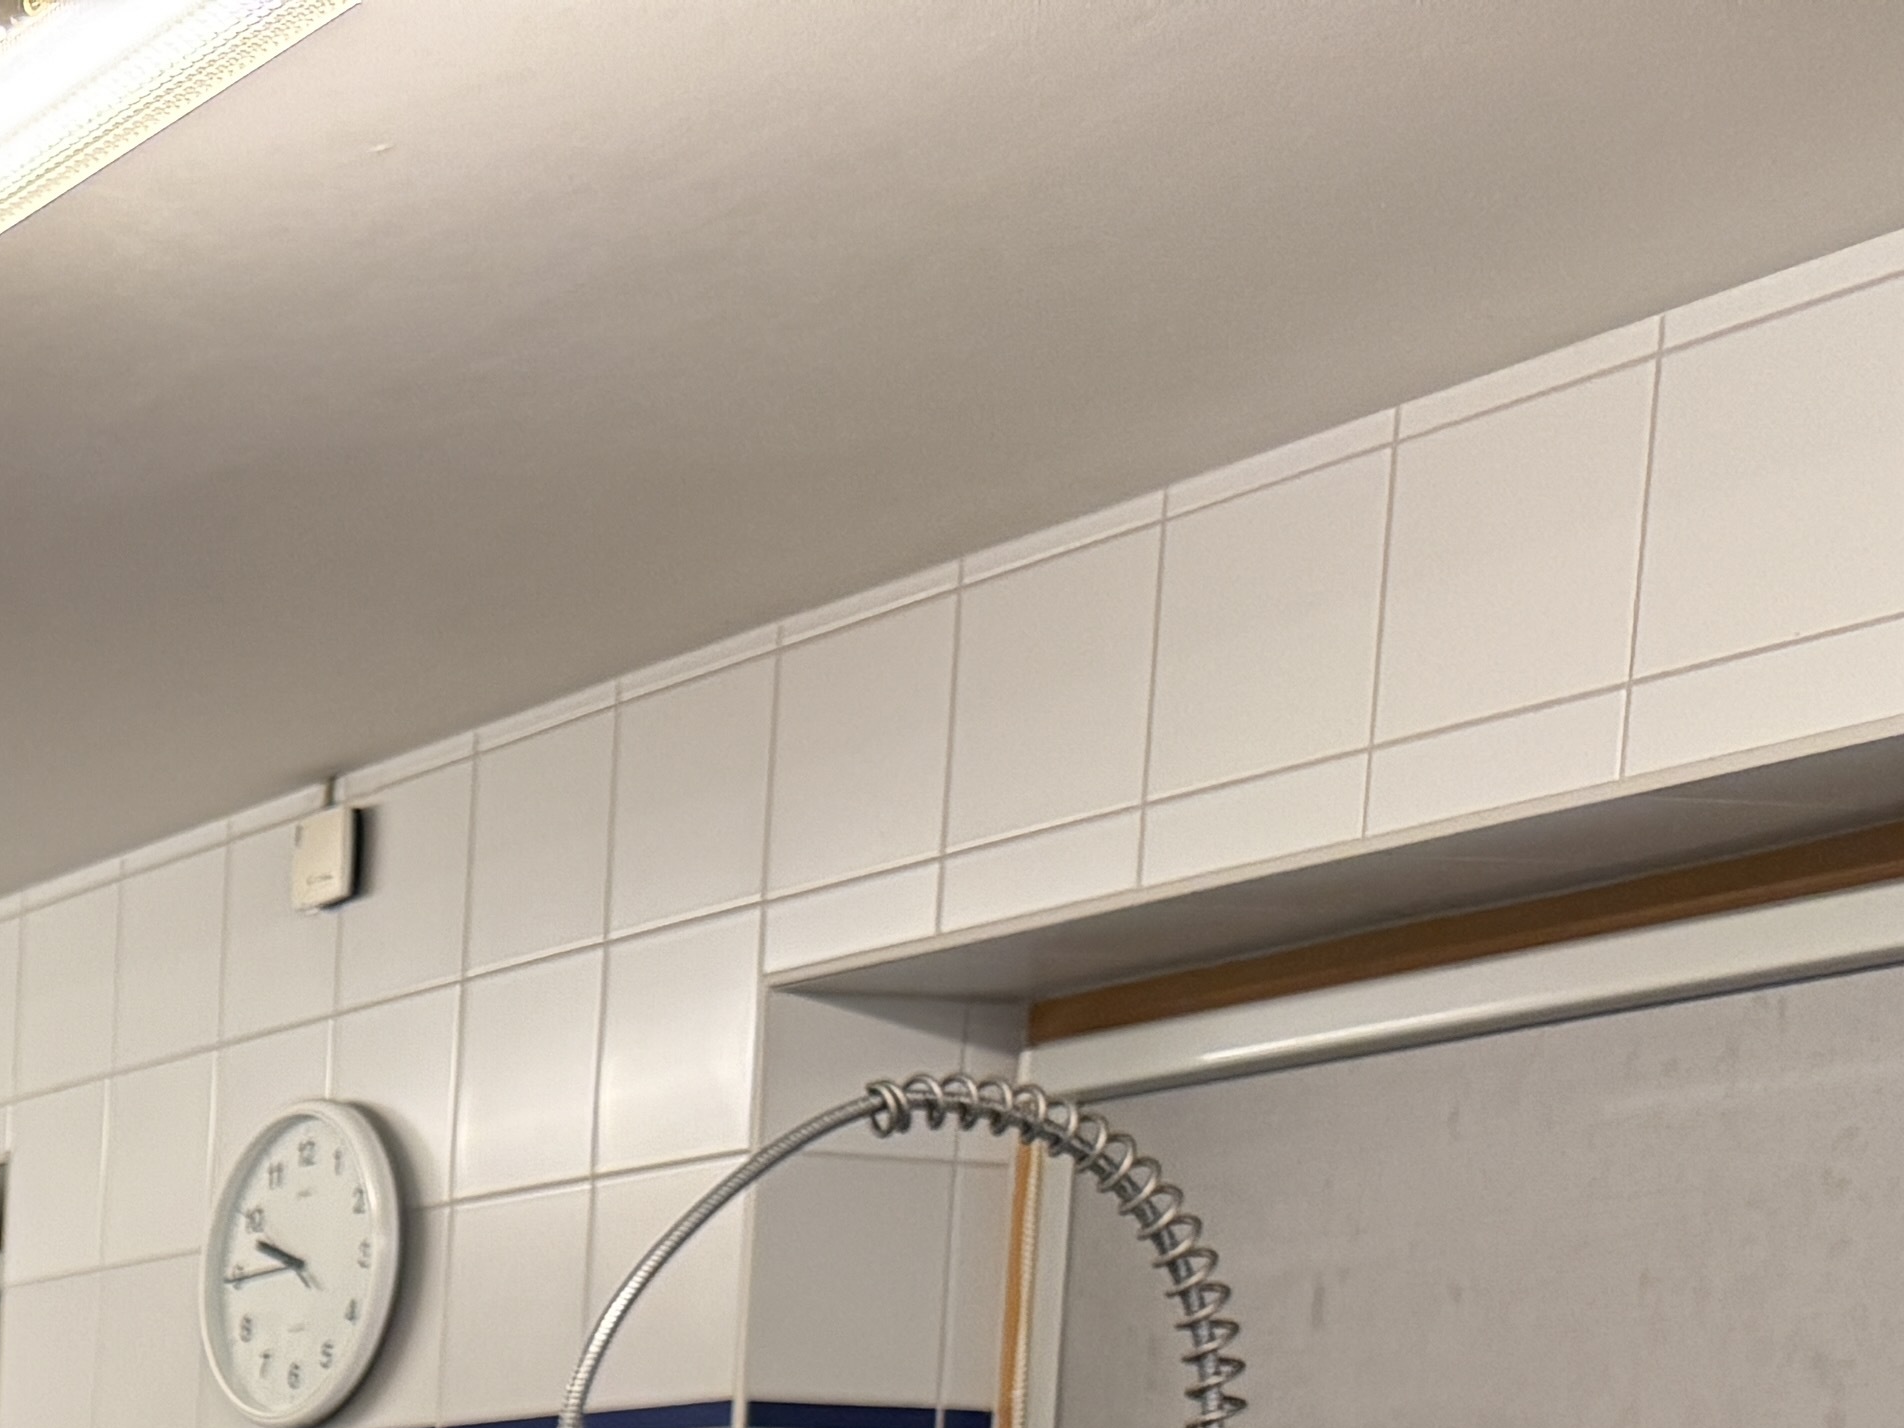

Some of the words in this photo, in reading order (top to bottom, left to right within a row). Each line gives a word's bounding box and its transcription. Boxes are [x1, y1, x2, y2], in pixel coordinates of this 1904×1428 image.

[298, 1140, 315, 1167] 12
[333, 1151, 344, 1175] 1
[268, 1164, 284, 1188] 11
[353, 1187, 365, 1214] 2
[245, 1209, 265, 1232] 10
[345, 1299, 358, 1323] 4
[240, 1317, 253, 1342] 8
[259, 1351, 272, 1377] 7
[321, 1342, 334, 1368] 5
[288, 1364, 300, 1389] 6
